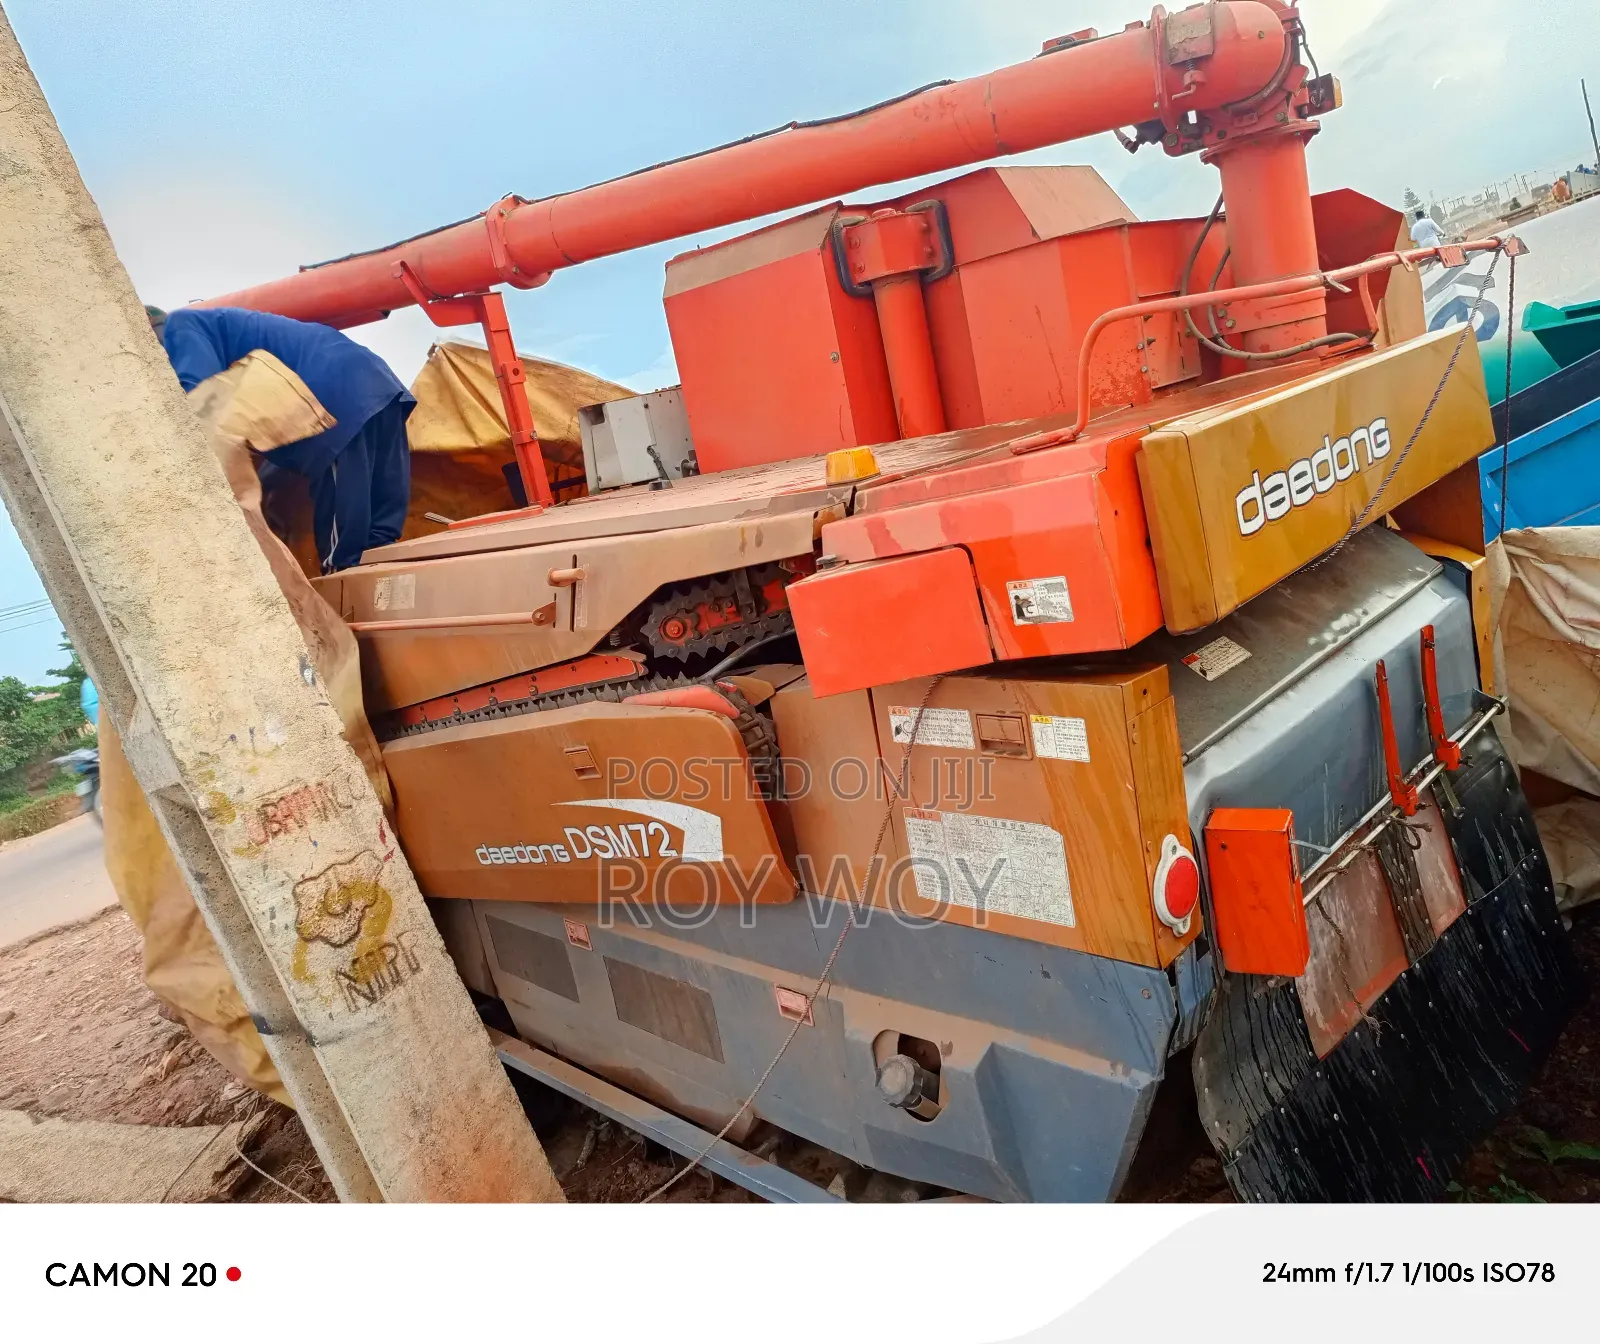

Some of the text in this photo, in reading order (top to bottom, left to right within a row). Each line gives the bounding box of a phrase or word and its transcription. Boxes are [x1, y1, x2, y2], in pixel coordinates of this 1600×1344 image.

[1234, 416, 1391, 537] daedong
[474, 821, 679, 866] daedong DSM72
